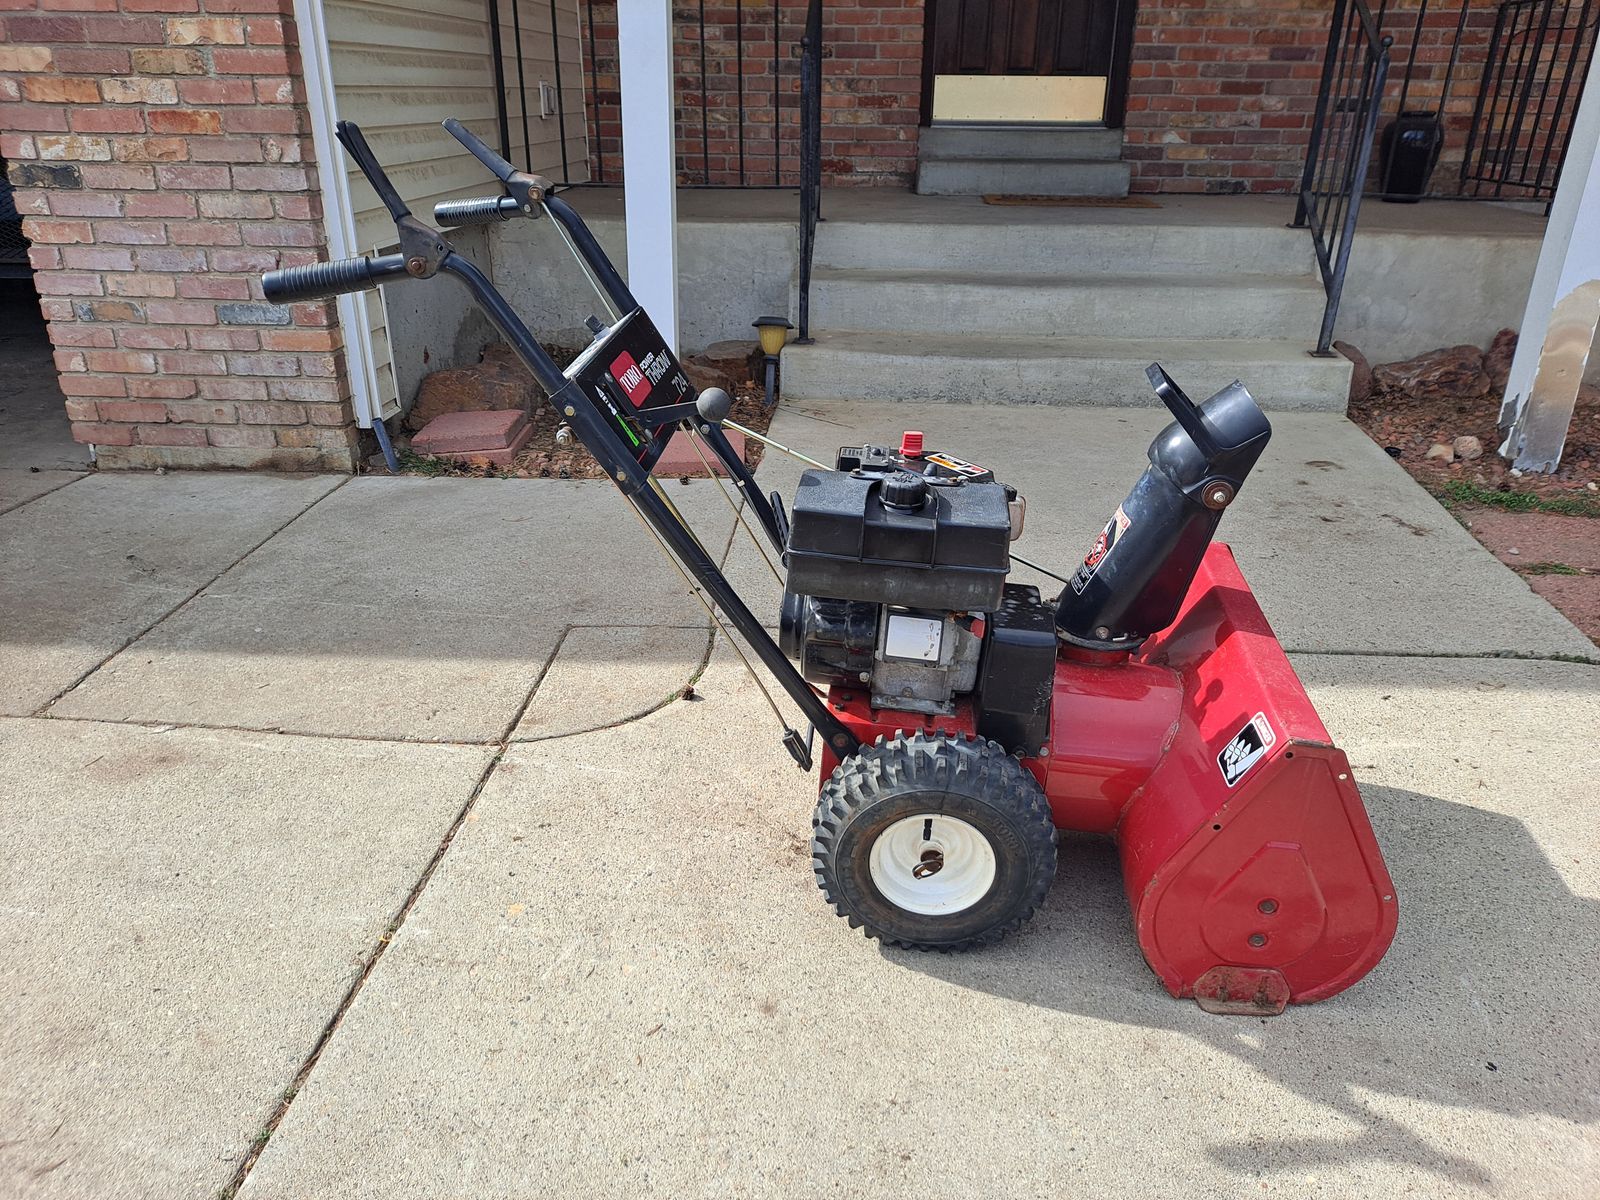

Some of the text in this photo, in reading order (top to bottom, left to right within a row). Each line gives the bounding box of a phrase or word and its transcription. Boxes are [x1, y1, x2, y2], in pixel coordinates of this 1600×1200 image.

[639, 352, 655, 372] POWER
[645, 349, 672, 386] THROW
[619, 364, 643, 394] TORO
[671, 372, 689, 396] 724
